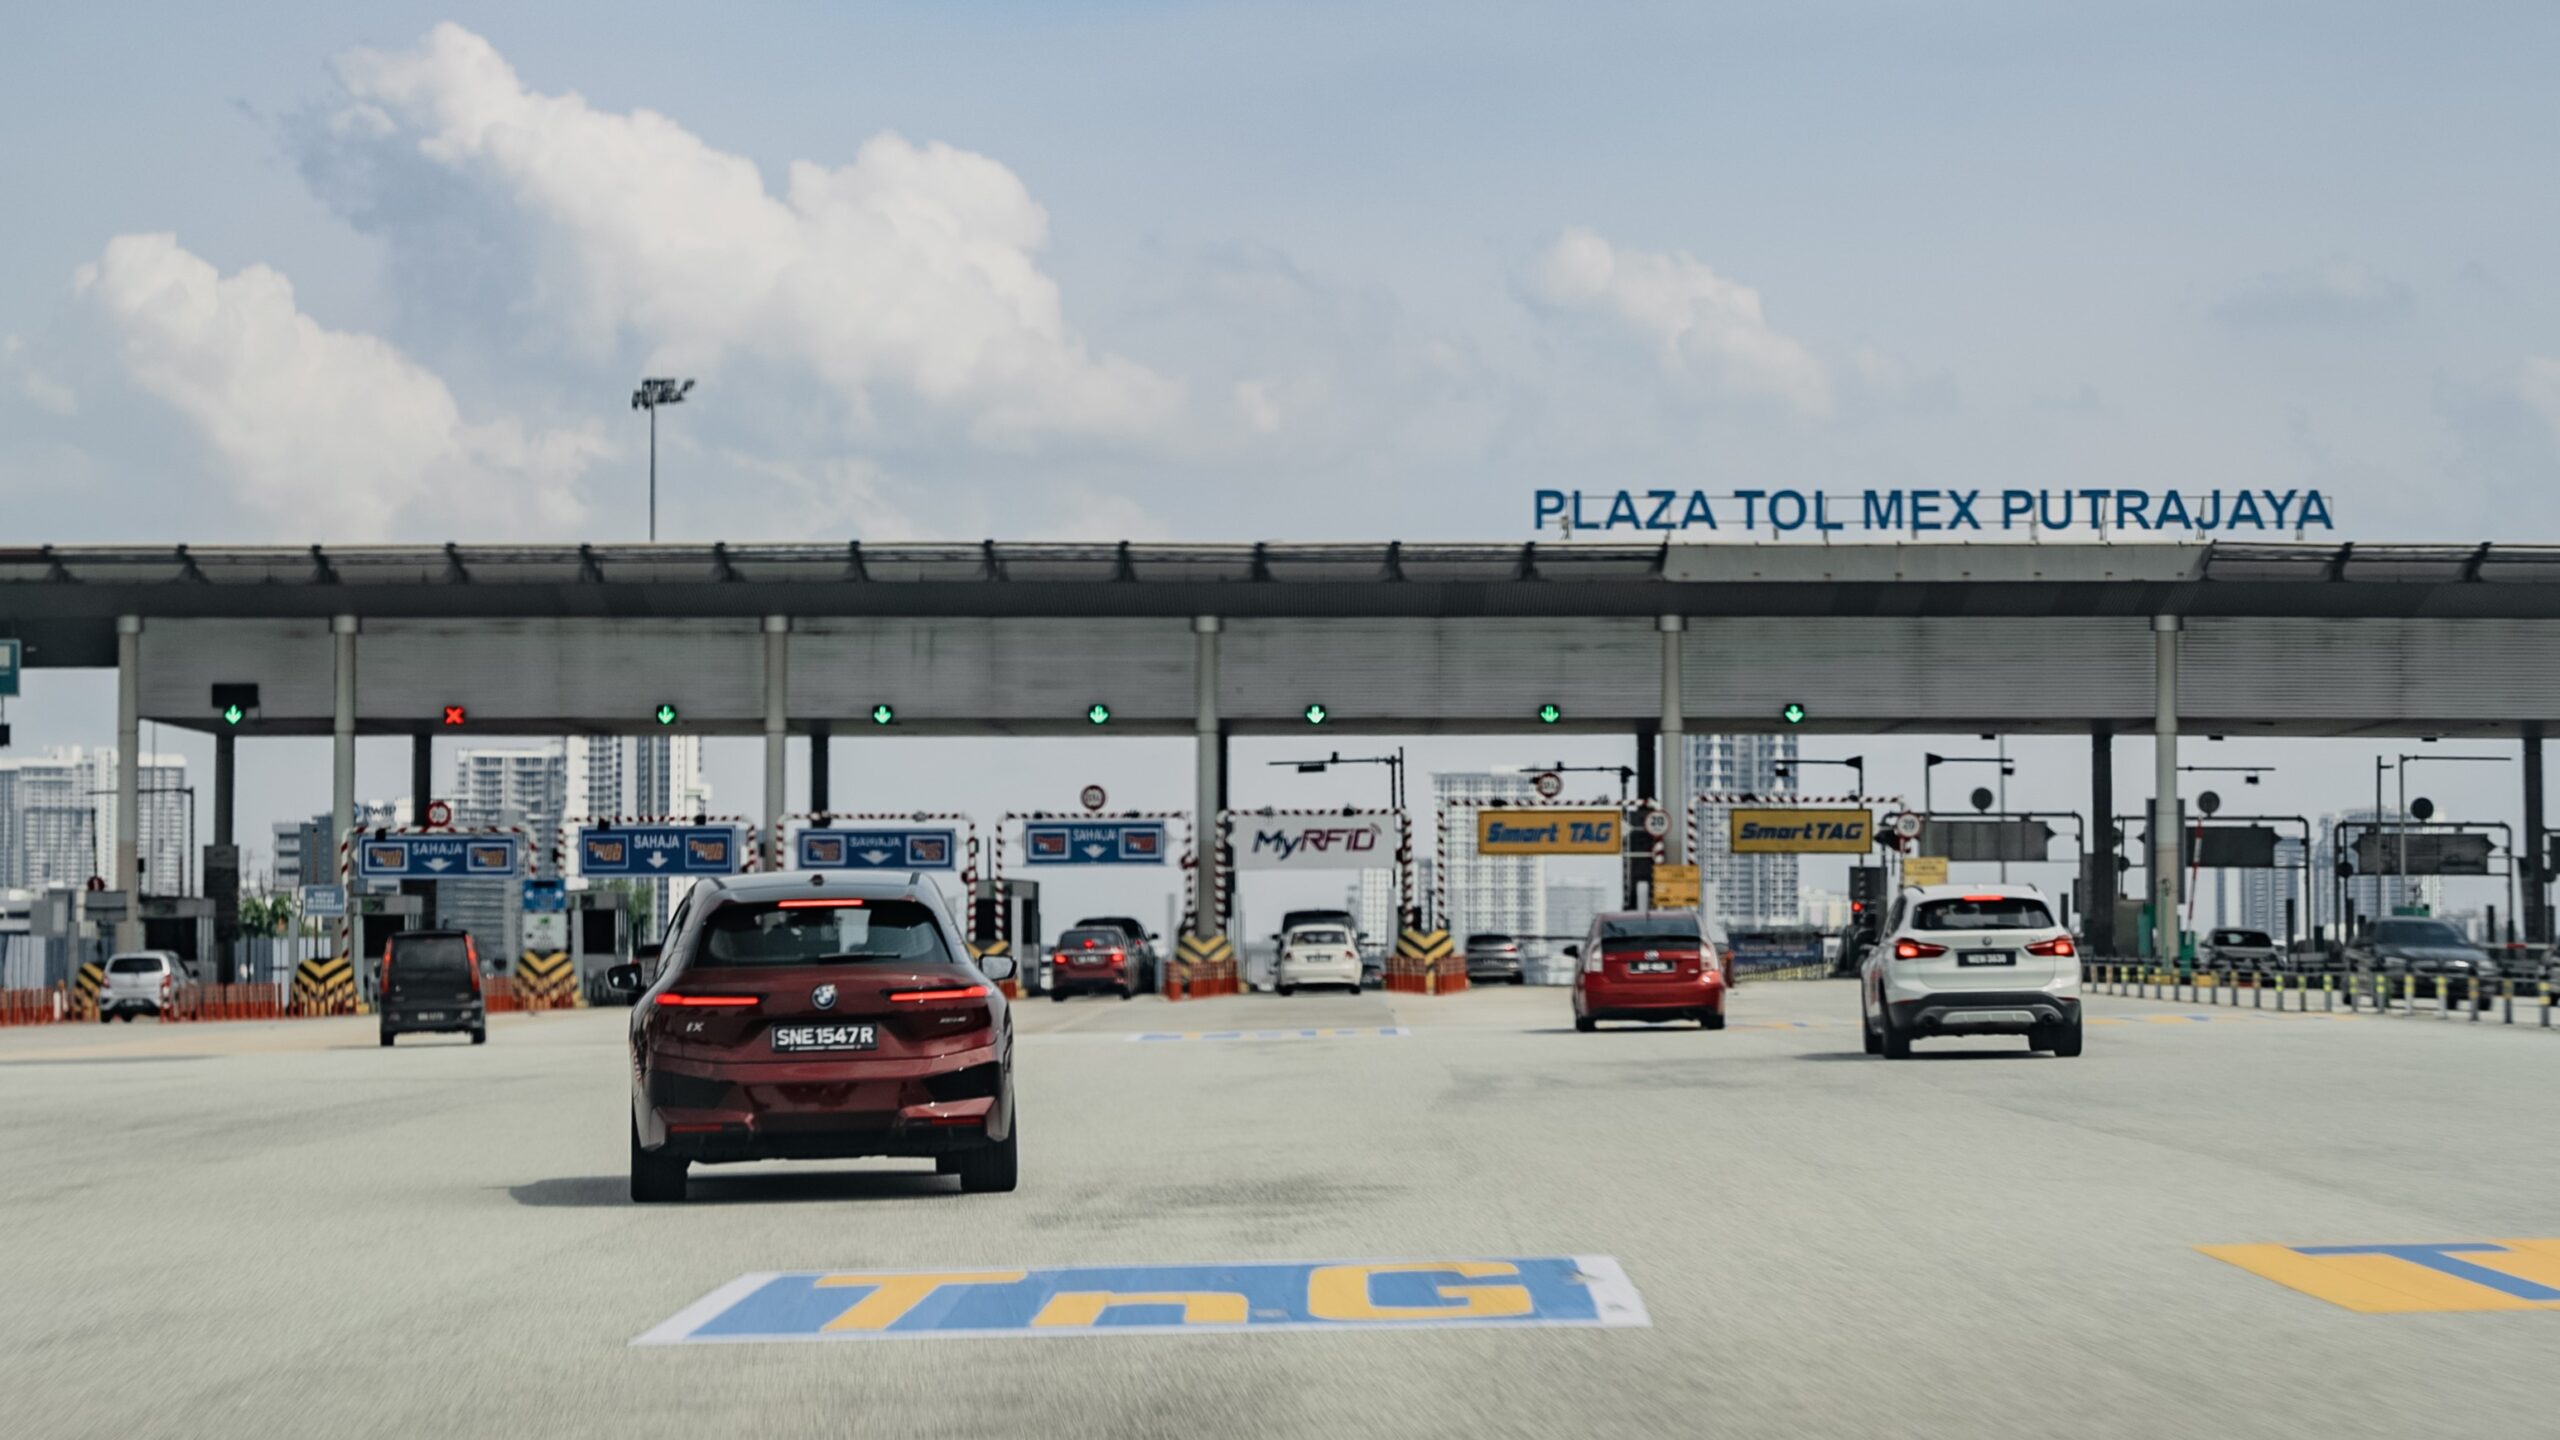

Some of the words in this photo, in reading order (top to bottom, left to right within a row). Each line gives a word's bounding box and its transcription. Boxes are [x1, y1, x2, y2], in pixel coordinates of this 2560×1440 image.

[1534, 490, 1718, 530] PLAZA
[1734, 490, 1844, 530] TOL
[1863, 490, 1982, 530] MEX
[2002, 490, 2334, 530] PUTRAJAYA
[633, 834, 680, 849] SAHAJA
[1487, 823, 1559, 843] Smart
[1568, 823, 1612, 843] TAG
[411, 843, 463, 856] SAHAJA
[776, 1026, 874, 1046] SNE1547R
[812, 1260, 1534, 1333] TnG
